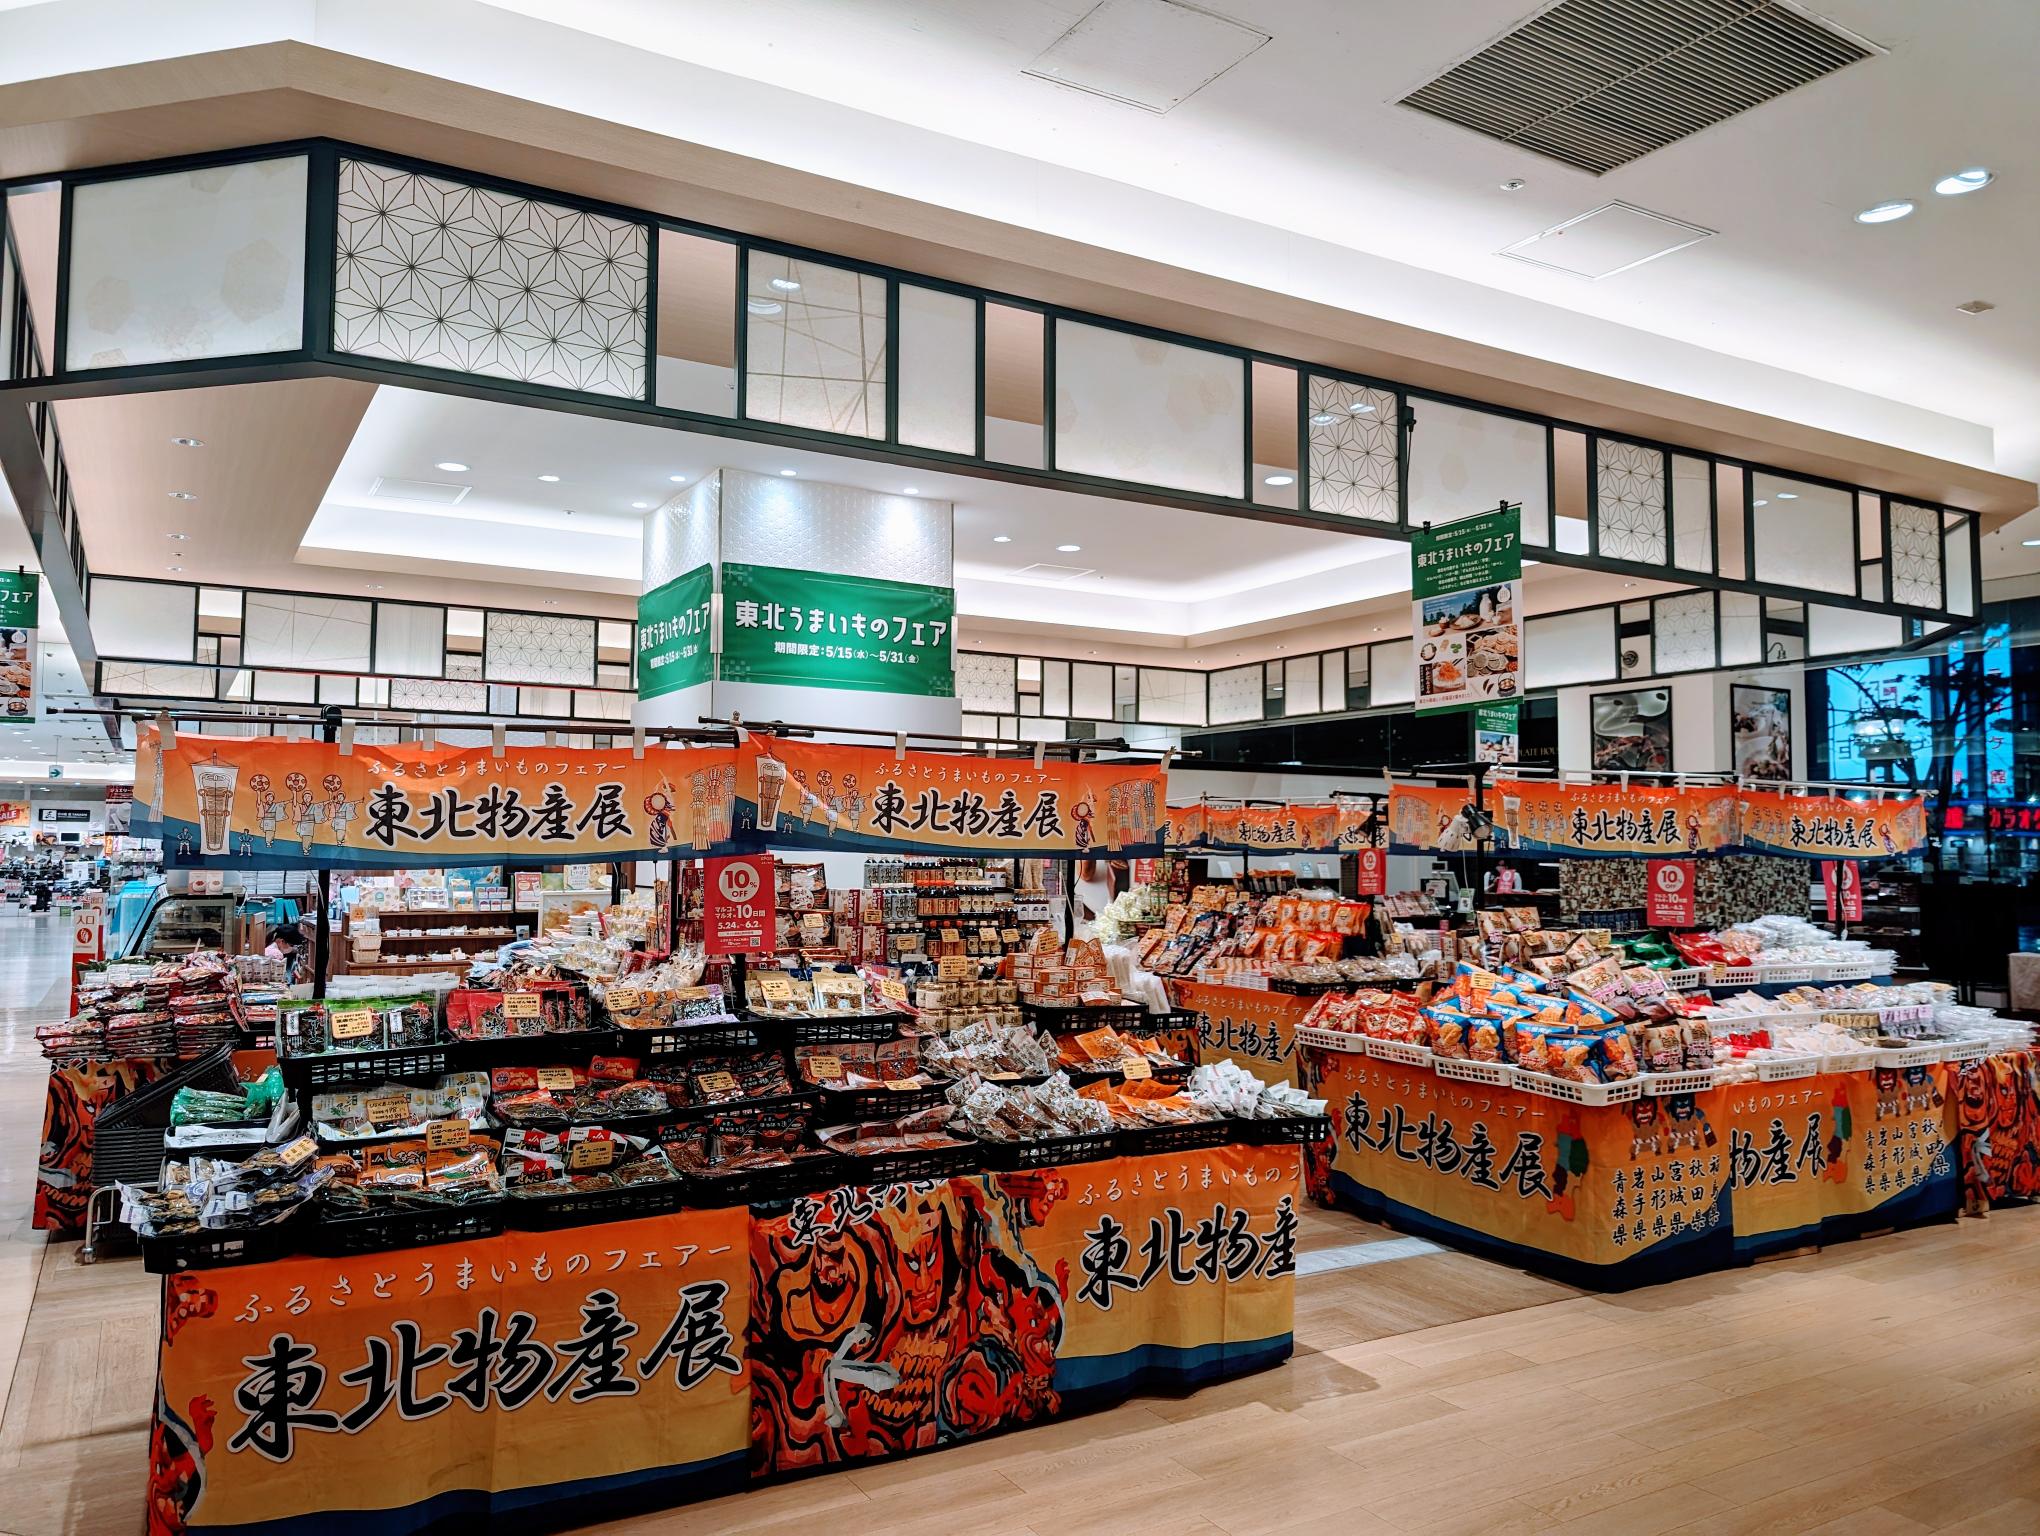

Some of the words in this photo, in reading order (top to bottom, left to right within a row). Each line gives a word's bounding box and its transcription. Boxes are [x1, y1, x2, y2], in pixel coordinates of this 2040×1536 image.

[1417, 532, 1515, 569] 東北うまいものフェア
[640, 602, 710, 652] 東北うまいものフェア
[735, 600, 947, 648] 東北うまいものフェア
[367, 758, 628, 777] ふるさとうまいものフェアー
[875, 762, 1062, 784] ふるさとうまいものフェアー
[365, 783, 634, 848] 東北物産展
[871, 782, 1066, 839] 東北物産展
[1570, 806, 1681, 846] 東北物産展
[1789, 814, 1878, 849] 東北物産展
[725, 869, 758, 889] 10%
[731, 890, 748, 898] OFF
[77, 915, 95, 926] 入口
[1197, 1011, 1299, 1065] 東北物産
[1344, 1066, 1545, 1119] ふるさとうまいものフェアー
[1343, 1090, 1554, 1202] 東北物産展
[1864, 1129, 1877, 1195] 青森県
[1877, 1127, 1891, 1192] 岩手県
[1891, 1126, 1906, 1188] 山形県
[1908, 1121, 1924, 1186] 宮城県
[1612, 1169, 1628, 1247] 青森県
[1631, 1167, 1647, 1242] 岩手県
[1651, 1166, 1668, 1238] 山形県
[1668, 1160, 1688, 1235] 宮城県
[1688, 1159, 1707, 1232] 秋田県
[234, 1243, 732, 1323] ふるさとうまいものフェアー
[227, 1279, 745, 1463] 東北物産展
